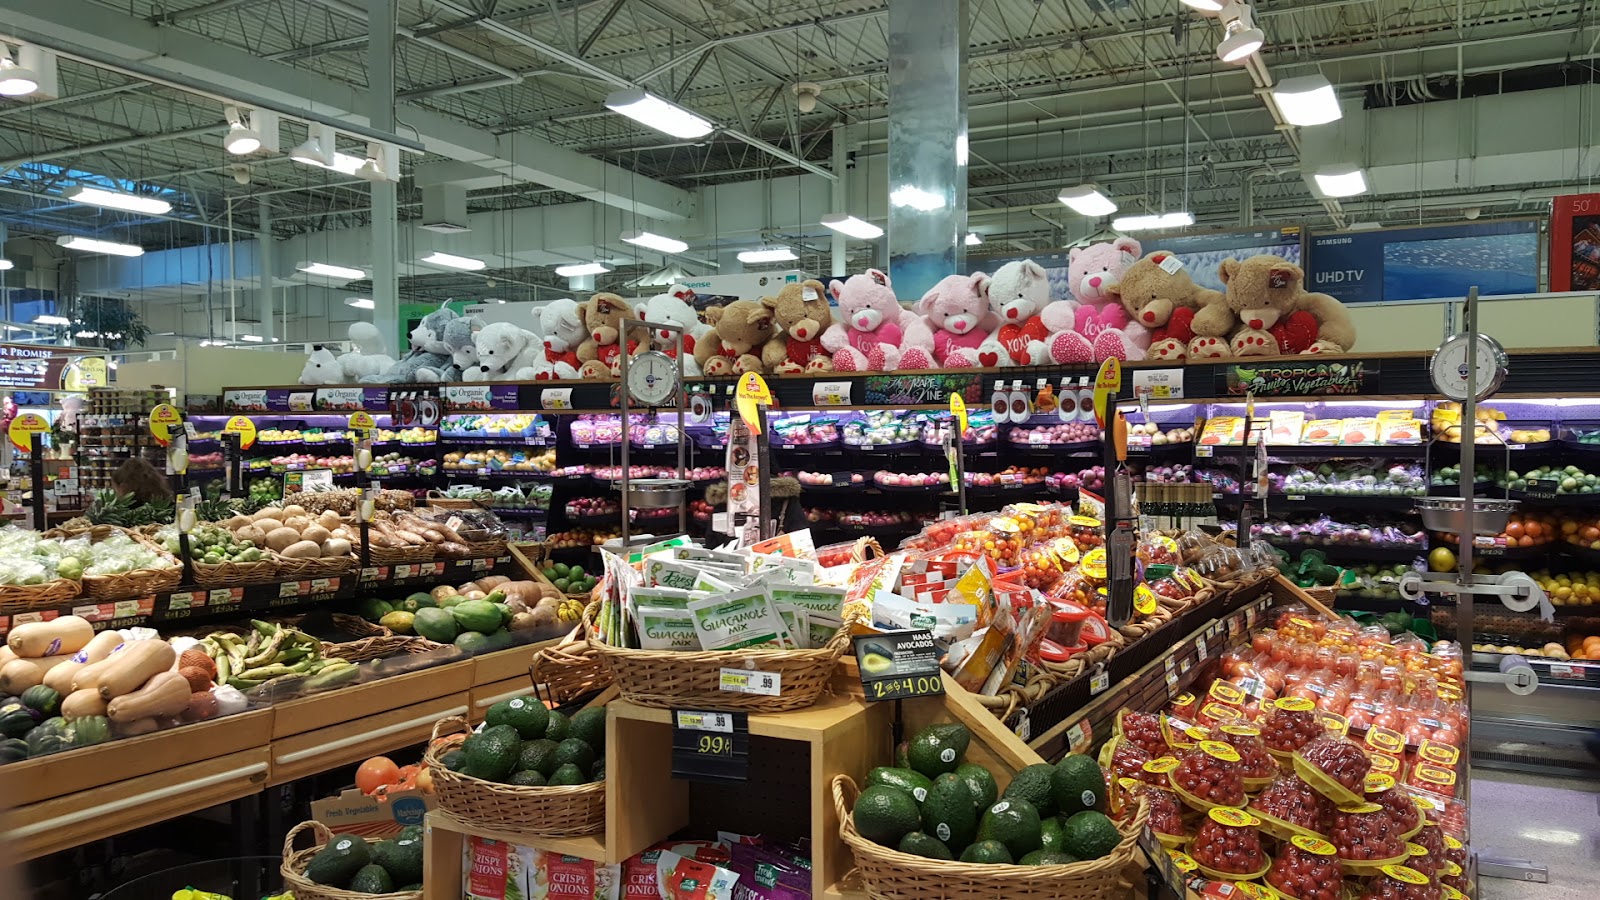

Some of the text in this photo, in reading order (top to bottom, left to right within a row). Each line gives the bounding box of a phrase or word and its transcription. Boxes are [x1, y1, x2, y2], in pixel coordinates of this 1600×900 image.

[1316, 237, 1352, 246] SAMSUNG
[1315, 269, 1364, 284] UHD TV
[1006, 333, 1031, 352] XOXO
[10, 347, 53, 359] PROMISE
[1257, 367, 1333, 379] TROPICAL
[1248, 377, 1287, 394] Fruits
[1291, 374, 1351, 395] Vegetables
[240, 392, 262, 400] Organic
[334, 389, 358, 398] Organic
[458, 387, 485, 398] Organic
[700, 607, 769, 632] GUACAMOLE
[646, 627, 698, 640] GUACAM
[912, 633, 932, 641] HAAS
[897, 640, 934, 650] AVOCADOS
[760, 677, 773, 689] .99
[874, 681, 886, 698] 2
[714, 716, 725, 727] .99
[326, 804, 379, 818] Fresh Vegetables
[757, 863, 773, 879] Fresh
[552, 872, 588, 885] CRISPY
[630, 874, 658, 885] CRIS
[550, 882, 590, 895] ONIONS
